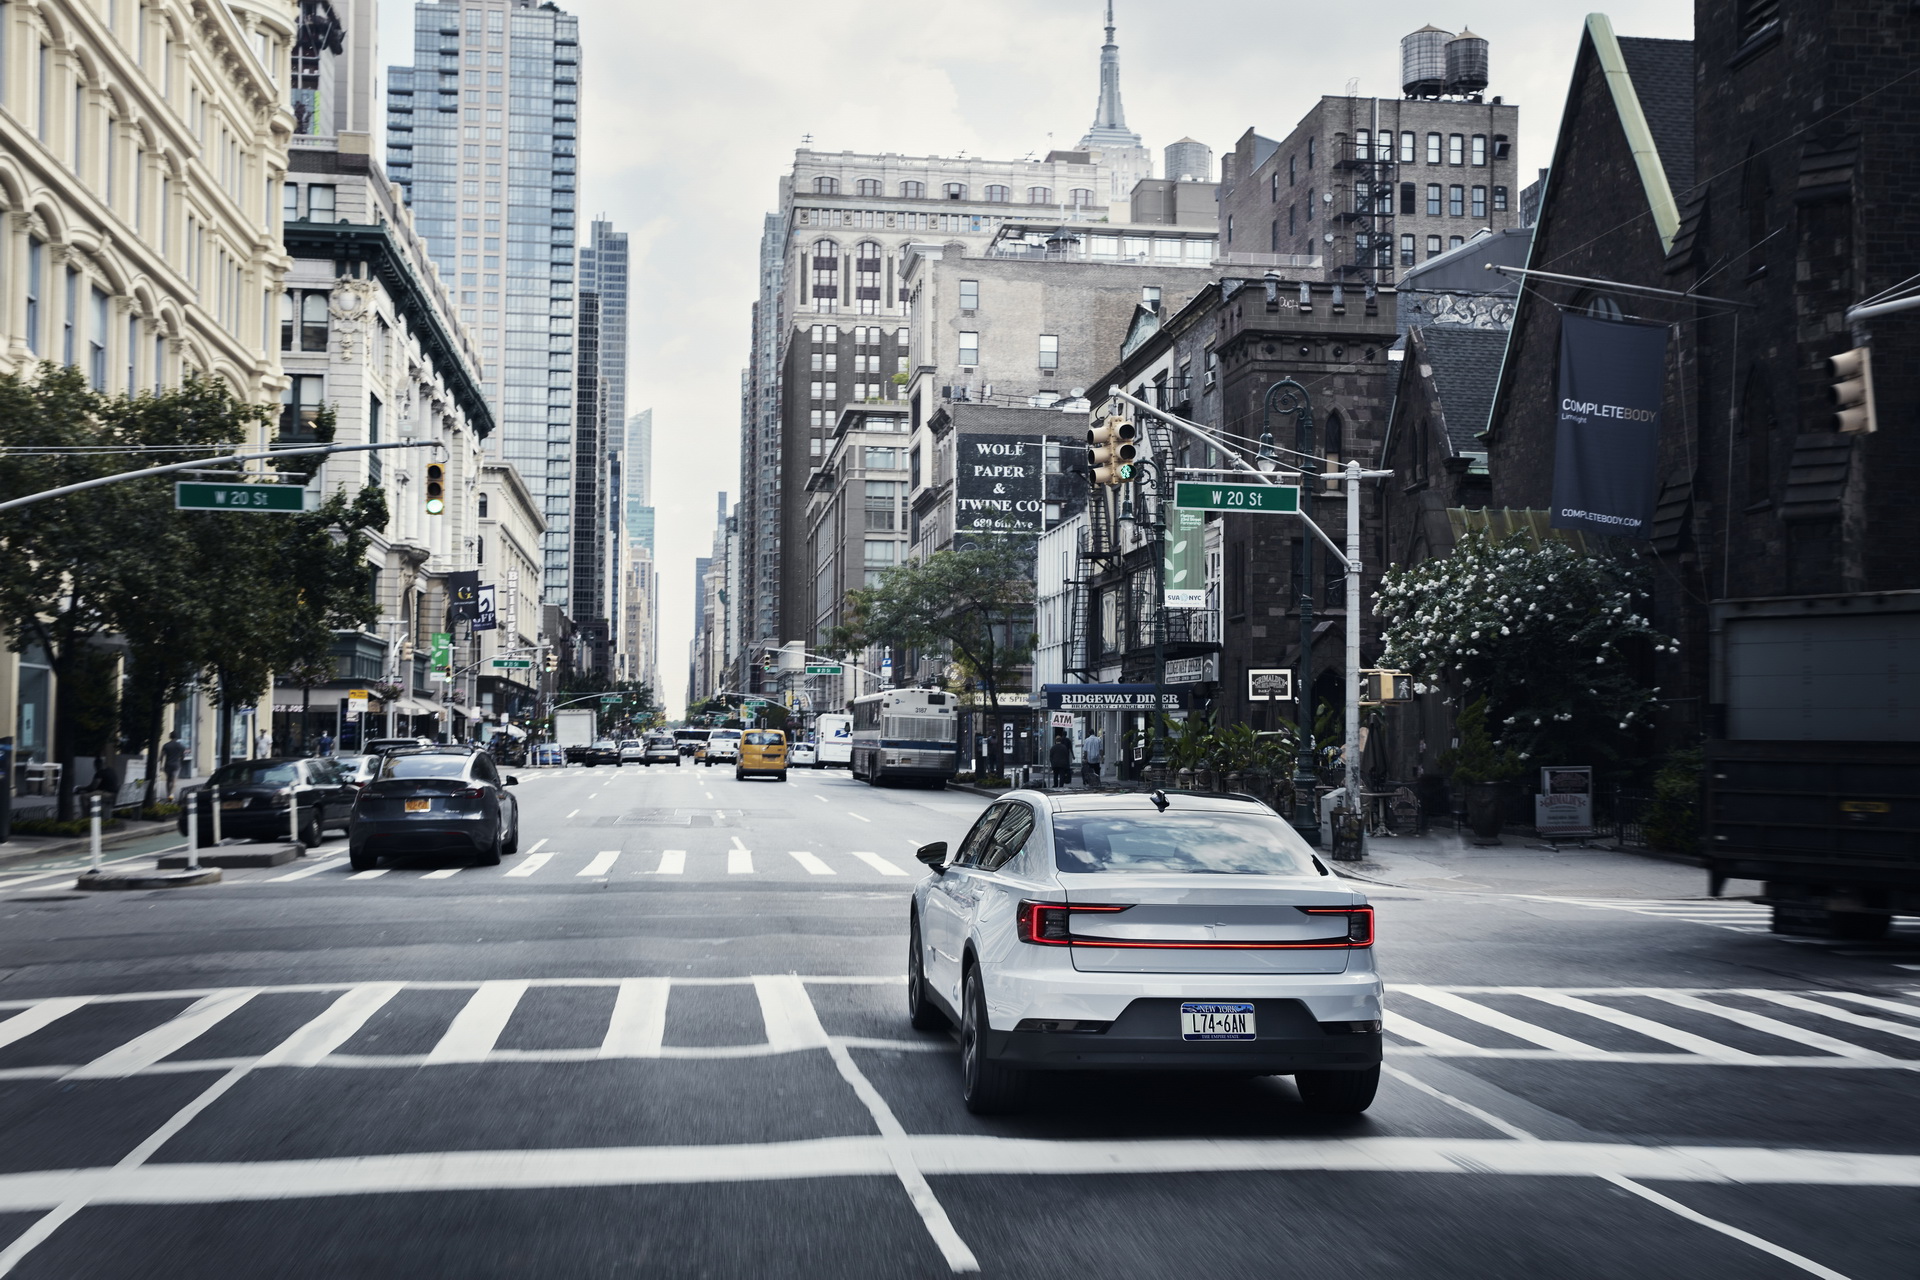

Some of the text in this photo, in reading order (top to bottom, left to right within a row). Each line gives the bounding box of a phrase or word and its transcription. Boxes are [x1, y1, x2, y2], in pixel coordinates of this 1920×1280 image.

[1562, 398, 1657, 423] COMPLETEBODY
[976, 443, 1025, 456] WOLF
[974, 465, 1025, 478] PAPER
[993, 482, 1006, 494] &
[214, 490, 269, 506] W 20 St
[958, 498, 1013, 511] TWINE
[1212, 490, 1263, 507] W 20 St
[1013, 519, 1034, 529] Ave
[1561, 508, 1642, 527] COMPLETEBODY.COM
[506, 571, 518, 657] Burlingto
[1061, 694, 1133, 704] RIDGEWAY
[1053, 715, 1072, 724] ATM
[1199, 1005, 1238, 1013] NEW YORK
